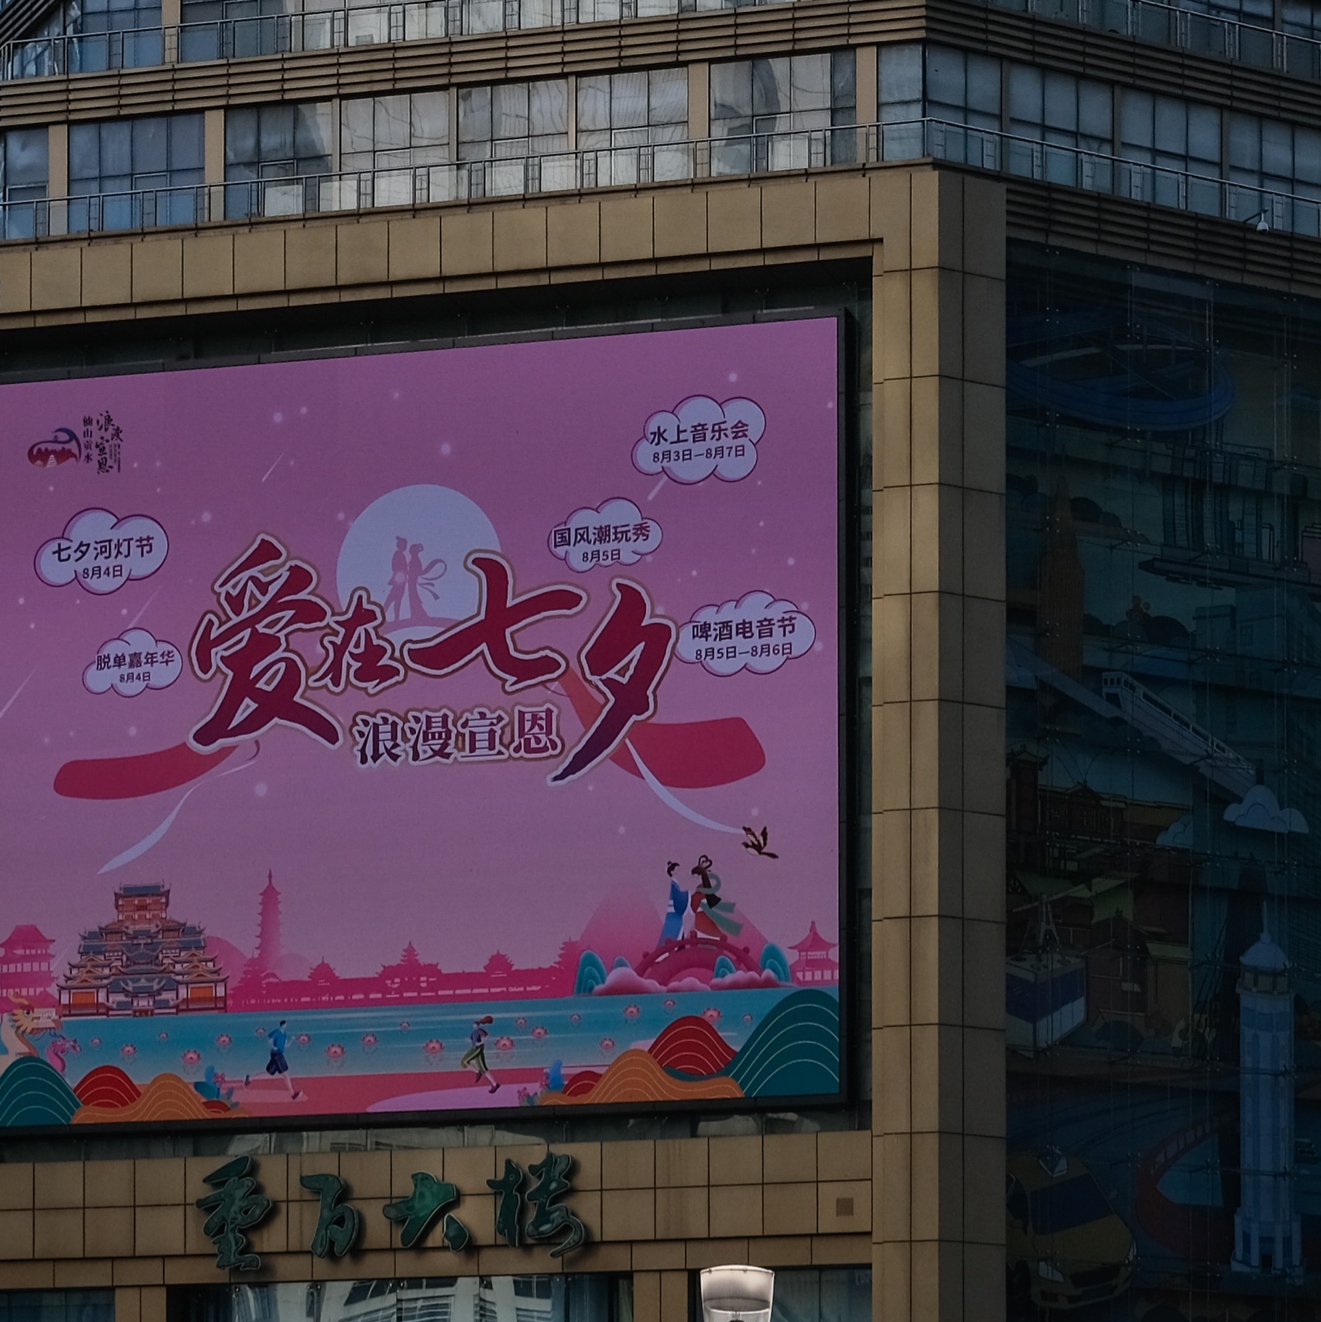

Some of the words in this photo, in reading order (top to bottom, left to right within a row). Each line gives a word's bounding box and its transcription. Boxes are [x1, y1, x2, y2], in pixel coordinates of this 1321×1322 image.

[650, 420, 749, 446] 水上音乐会
[553, 522, 651, 548] 国风潮玩秀
[52, 536, 154, 563] 七夕河灯节
[582, 549, 621, 563] 8月5日
[82, 565, 123, 580] 8月4日
[691, 615, 797, 642] 啤酒电音节
[96, 650, 175, 671] 脱单嘉年华
[190, 534, 673, 783] 爱在七夕
[119, 672, 151, 683] 8月4日
[354, 706, 561, 765] 浪漫宣恩
